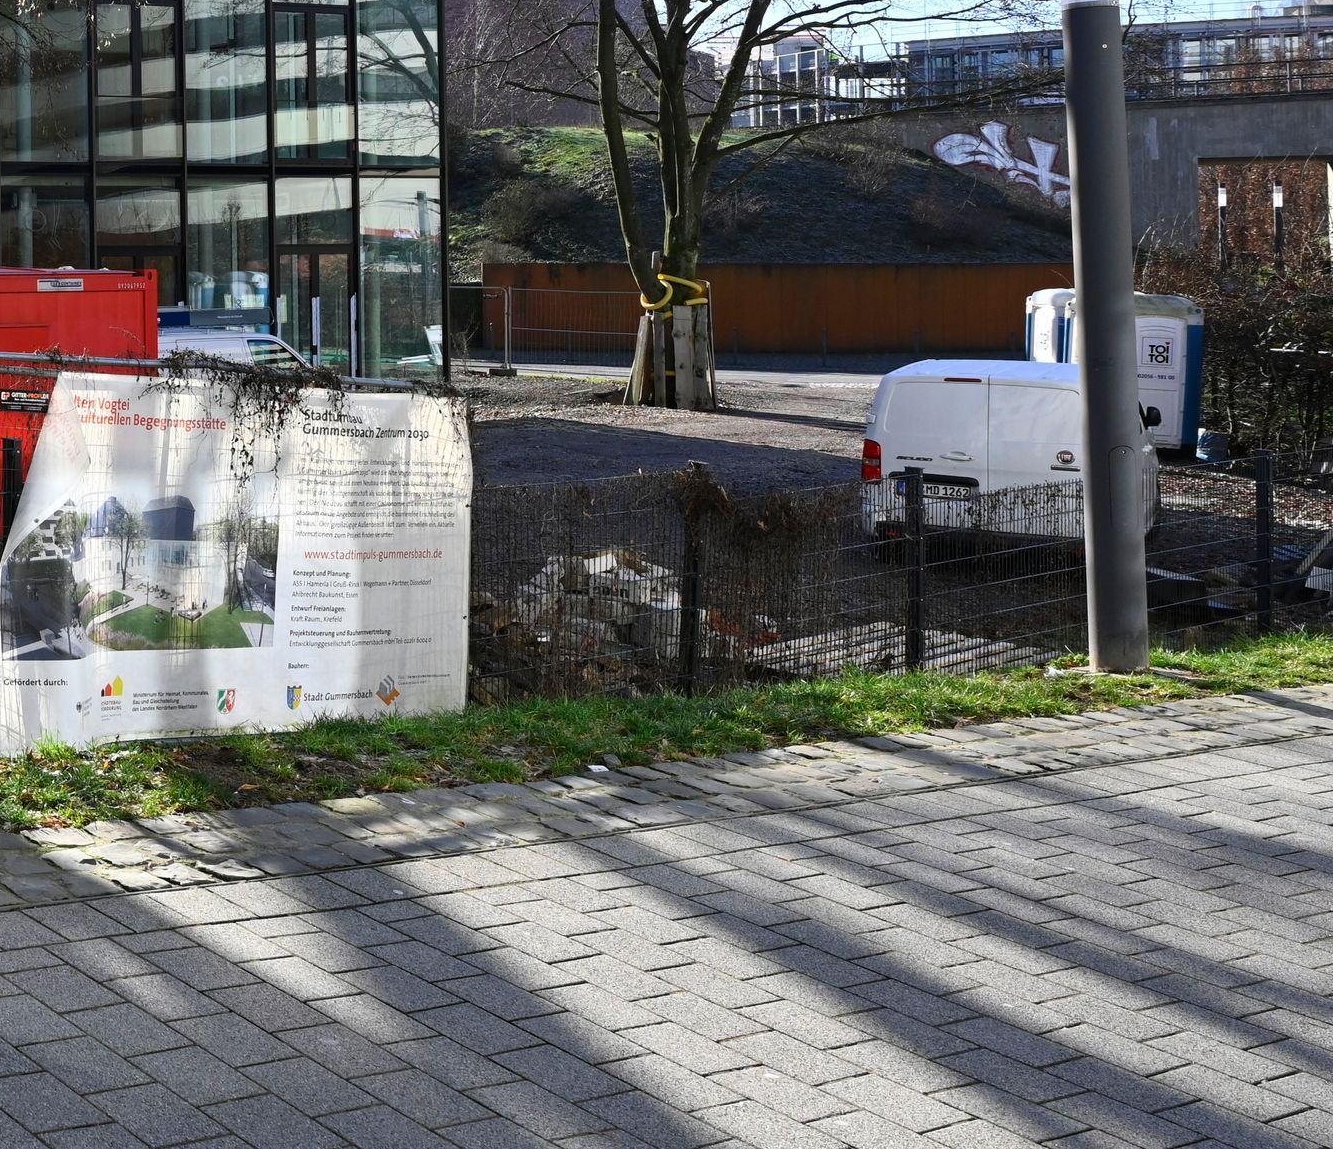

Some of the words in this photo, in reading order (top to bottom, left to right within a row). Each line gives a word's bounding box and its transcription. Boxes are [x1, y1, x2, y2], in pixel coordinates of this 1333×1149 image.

[1148, 342, 1170, 354] TOI
[1148, 354, 1169, 364] TOI
[73, 394, 96, 409] lten
[98, 397, 130, 416] Vogtei
[133, 414, 227, 432] Begegnungsstätte
[303, 423, 375, 439] Gummersbach
[376, 427, 406, 440] Zentrum
[408, 430, 429, 442] 2030
[942, 486, 969, 498] 1262
[304, 548, 443, 562] www.stadtimpuls-gummersbach.de
[293, 570, 315, 578] Konzept
[327, 570, 351, 579] Planung:
[409, 578, 432, 587] Düsseldorf
[292, 591, 318, 599] Ahlbrecht
[319, 591, 345, 599] Baukunst,
[291, 604, 313, 612] Entwurf
[313, 605, 346, 614] Freianlagen:
[323, 615, 342, 623] Krefeld
[289, 629, 335, 638] Projektsteuerung
[352, 638, 384, 647] Gummersbach
[3, 678, 42, 686] Gefördert
[43, 678, 68, 686] durch:
[303, 691, 323, 702] Stadt
[325, 689, 373, 701] Gummersbach
